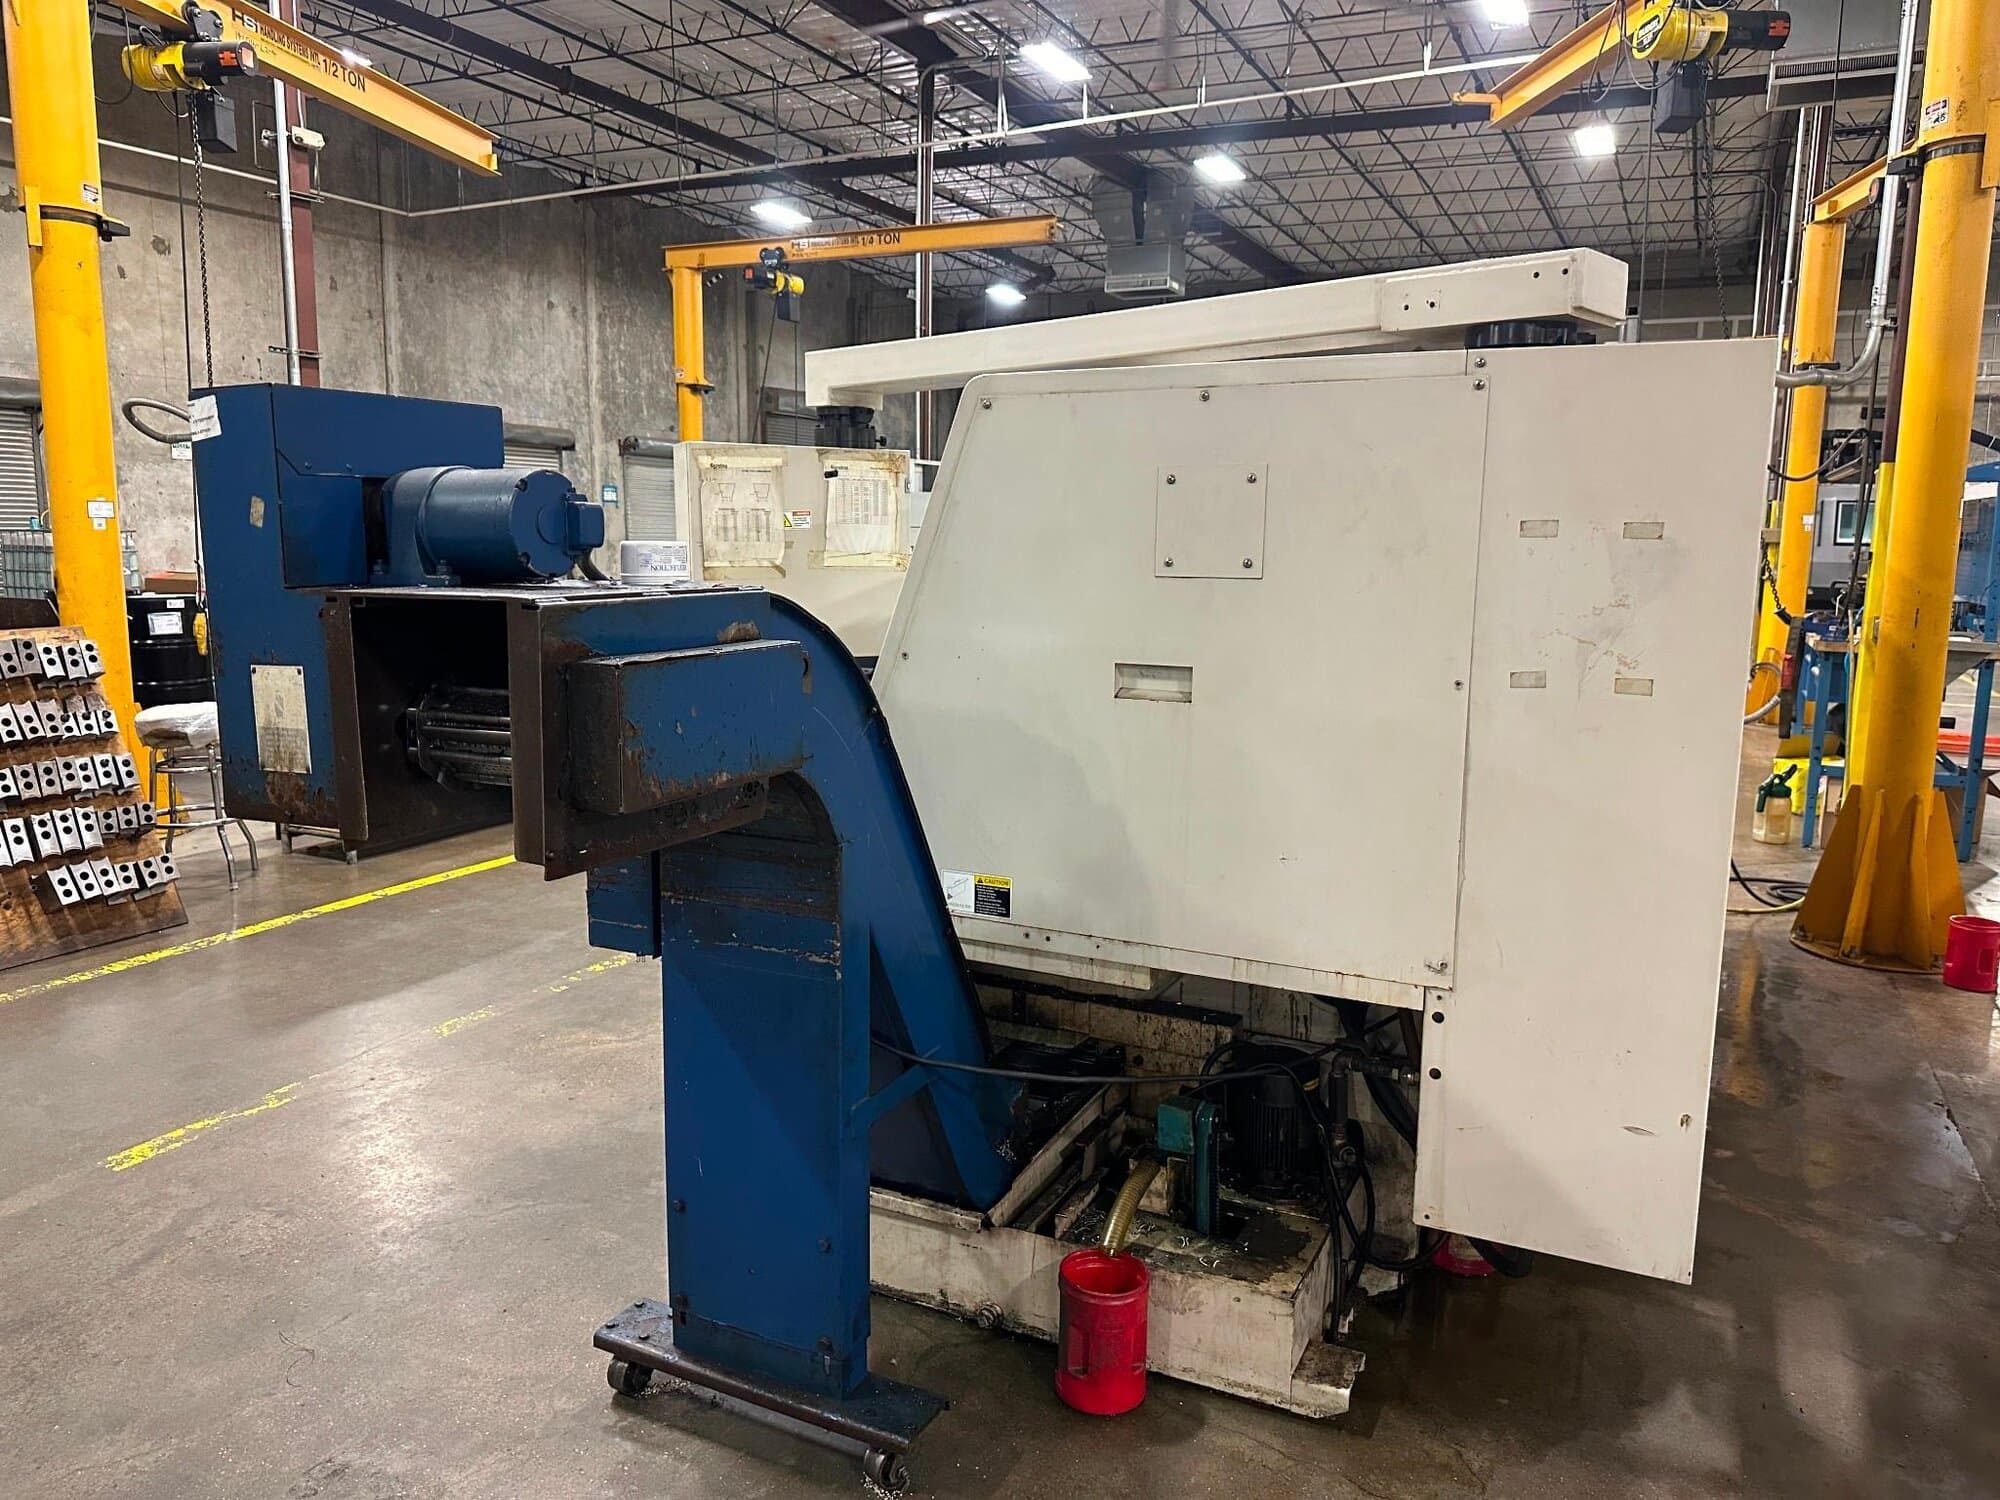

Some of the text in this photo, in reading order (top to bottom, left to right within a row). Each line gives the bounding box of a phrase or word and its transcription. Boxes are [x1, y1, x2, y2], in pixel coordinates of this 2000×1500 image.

[260, 24, 286, 47] HANDLING
[286, 37, 309, 59] SYSTEMS
[322, 59, 339, 77] 1/2
[342, 66, 366, 92] TON
[861, 236, 874, 246] 1/4
[876, 232, 900, 245] TON
[984, 878, 1009, 886] CAUTION
